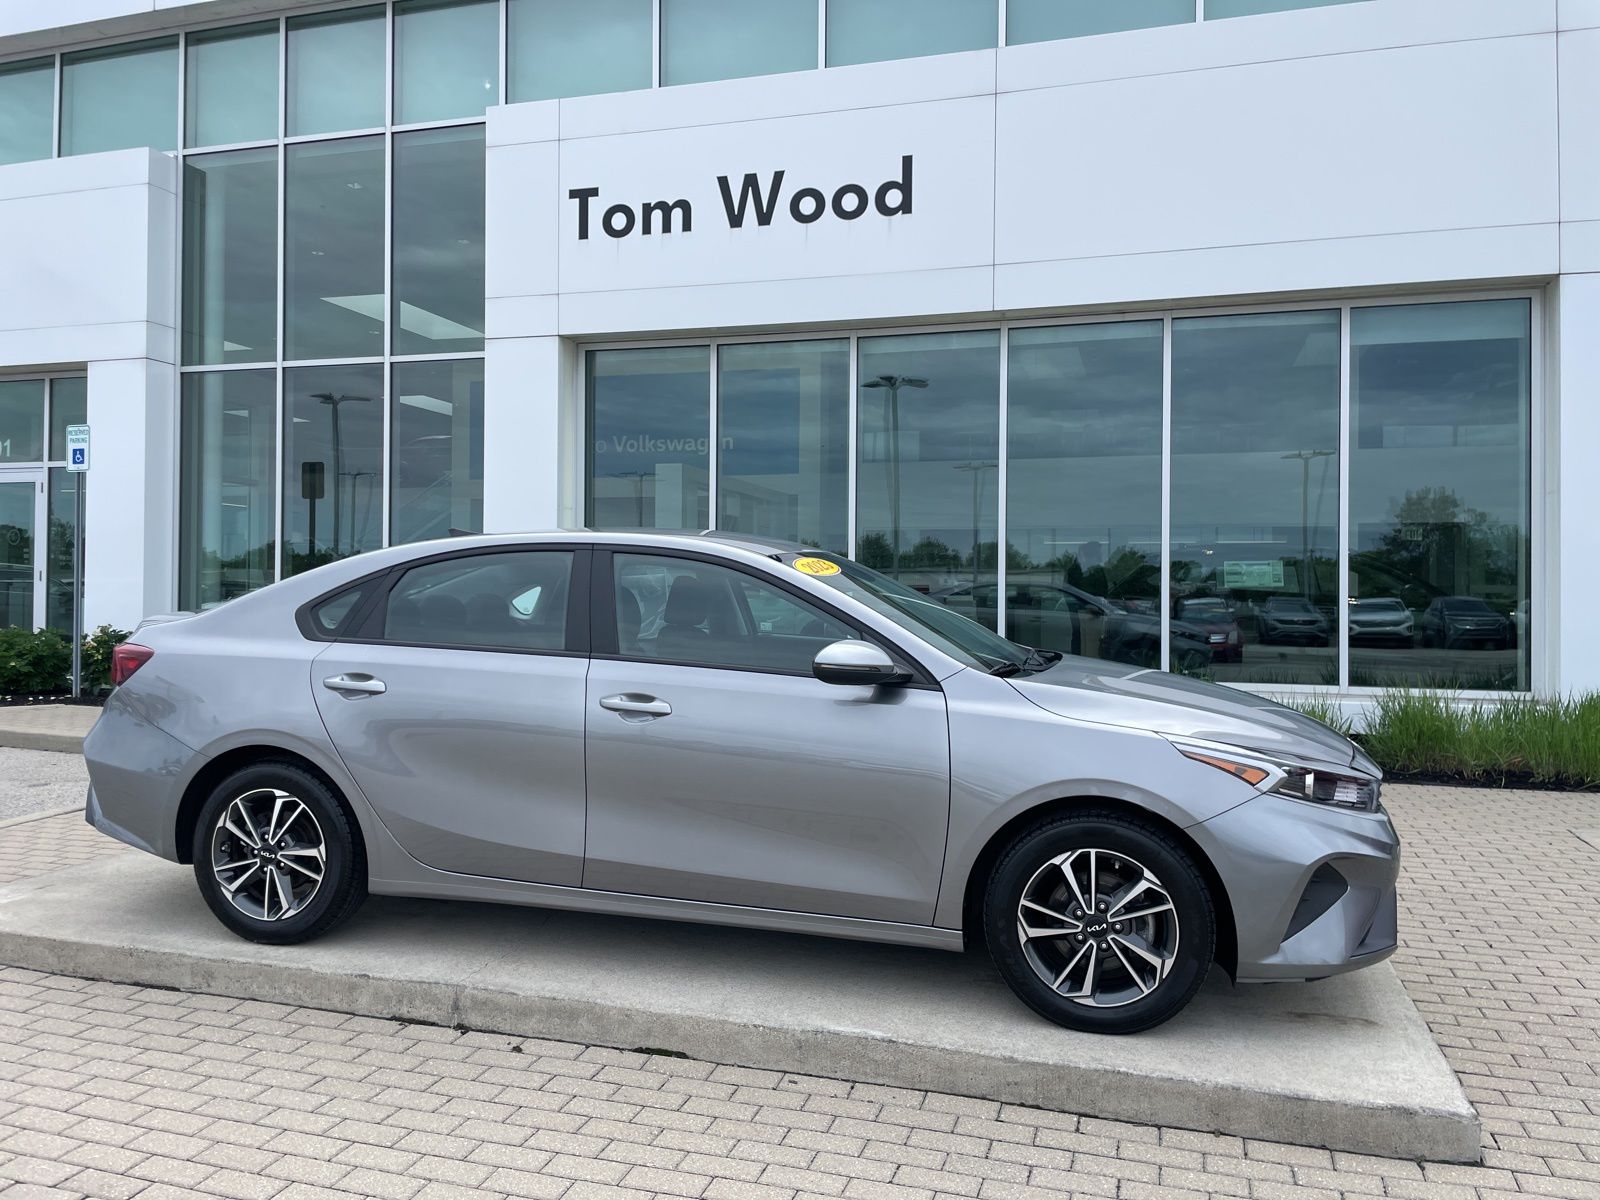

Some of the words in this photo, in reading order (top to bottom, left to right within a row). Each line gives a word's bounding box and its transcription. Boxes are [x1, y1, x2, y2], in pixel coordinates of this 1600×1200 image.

[568, 186, 692, 241] Tom
[716, 154, 914, 229] Wood
[612, 434, 734, 455] Volkswagn
